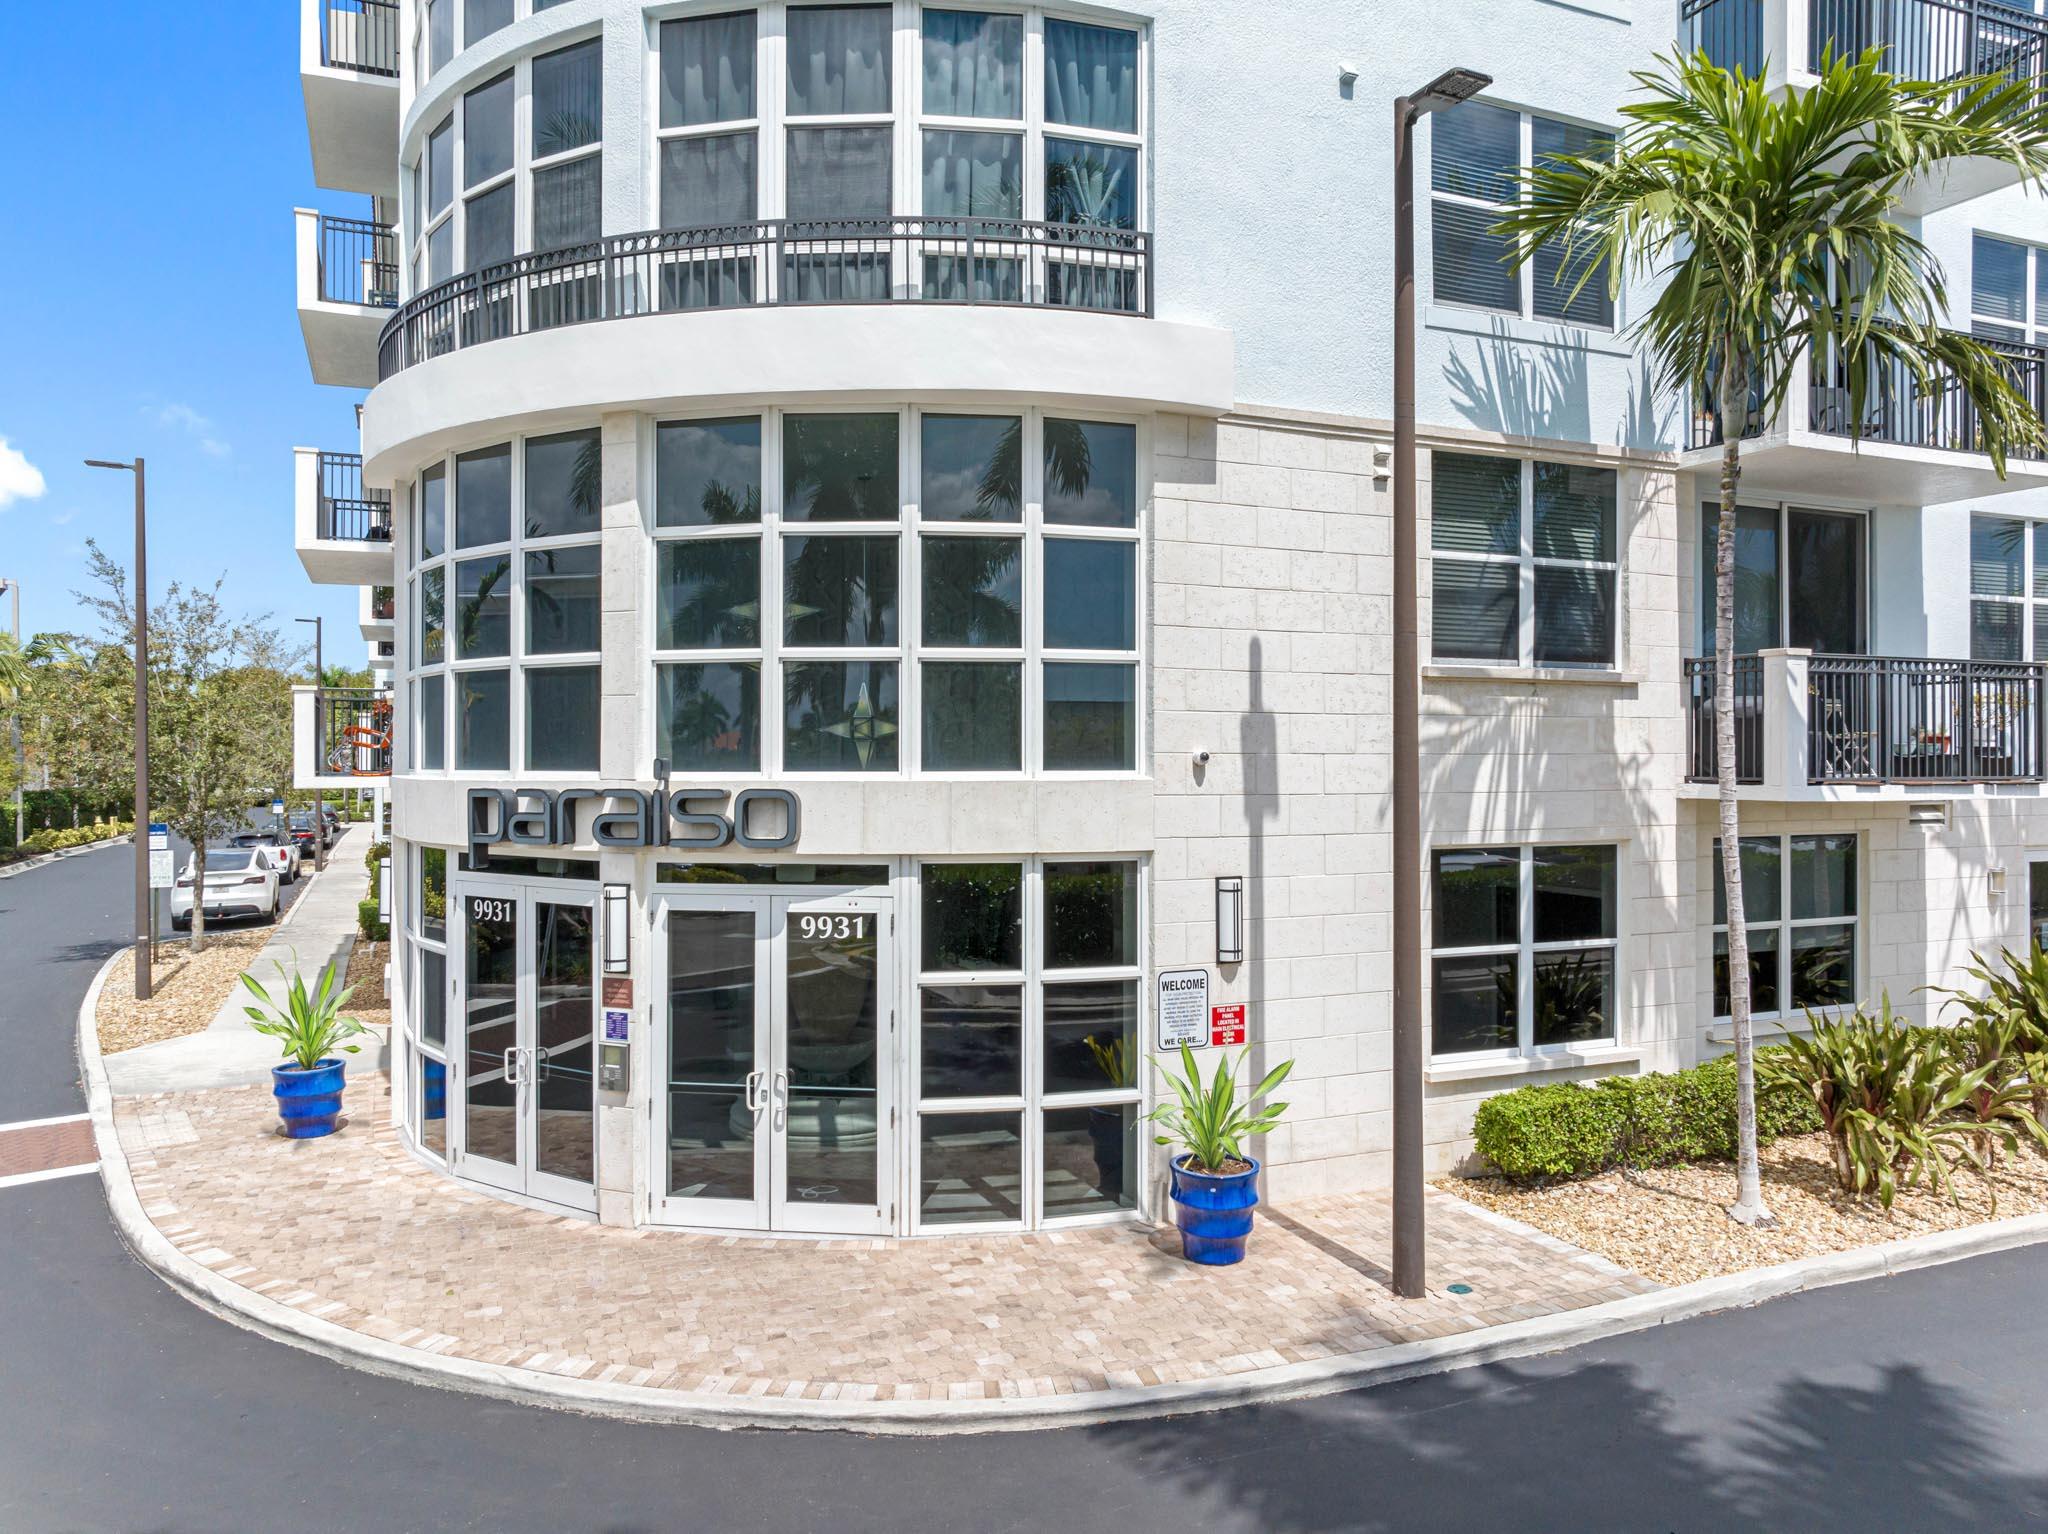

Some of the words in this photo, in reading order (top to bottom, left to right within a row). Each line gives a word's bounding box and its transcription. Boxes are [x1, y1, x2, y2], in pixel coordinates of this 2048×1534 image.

[467, 758, 801, 869] paraiso
[473, 899, 511, 922] 9931
[800, 915, 864, 939] 9931
[1161, 978, 1205, 992] WELCOME
[1164, 1038, 1175, 1046] WE
